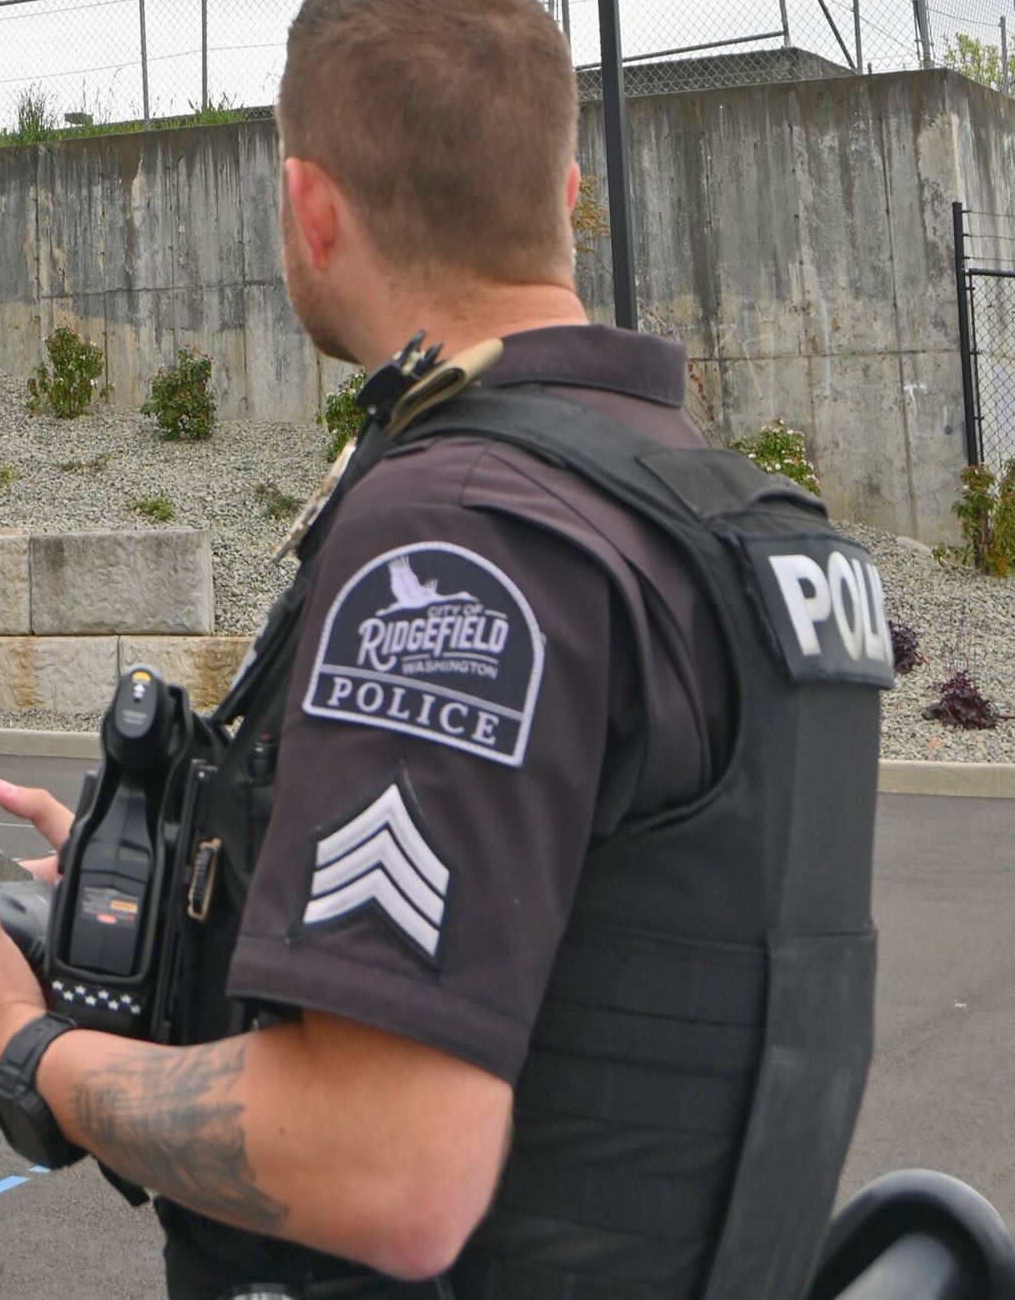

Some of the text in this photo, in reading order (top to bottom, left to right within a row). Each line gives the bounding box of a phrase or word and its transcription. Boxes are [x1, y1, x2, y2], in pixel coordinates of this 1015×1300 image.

[427, 604, 484, 617] CITY OF
[401, 659, 498, 679] WASHINGTON
[327, 677, 499, 745] POLICE
